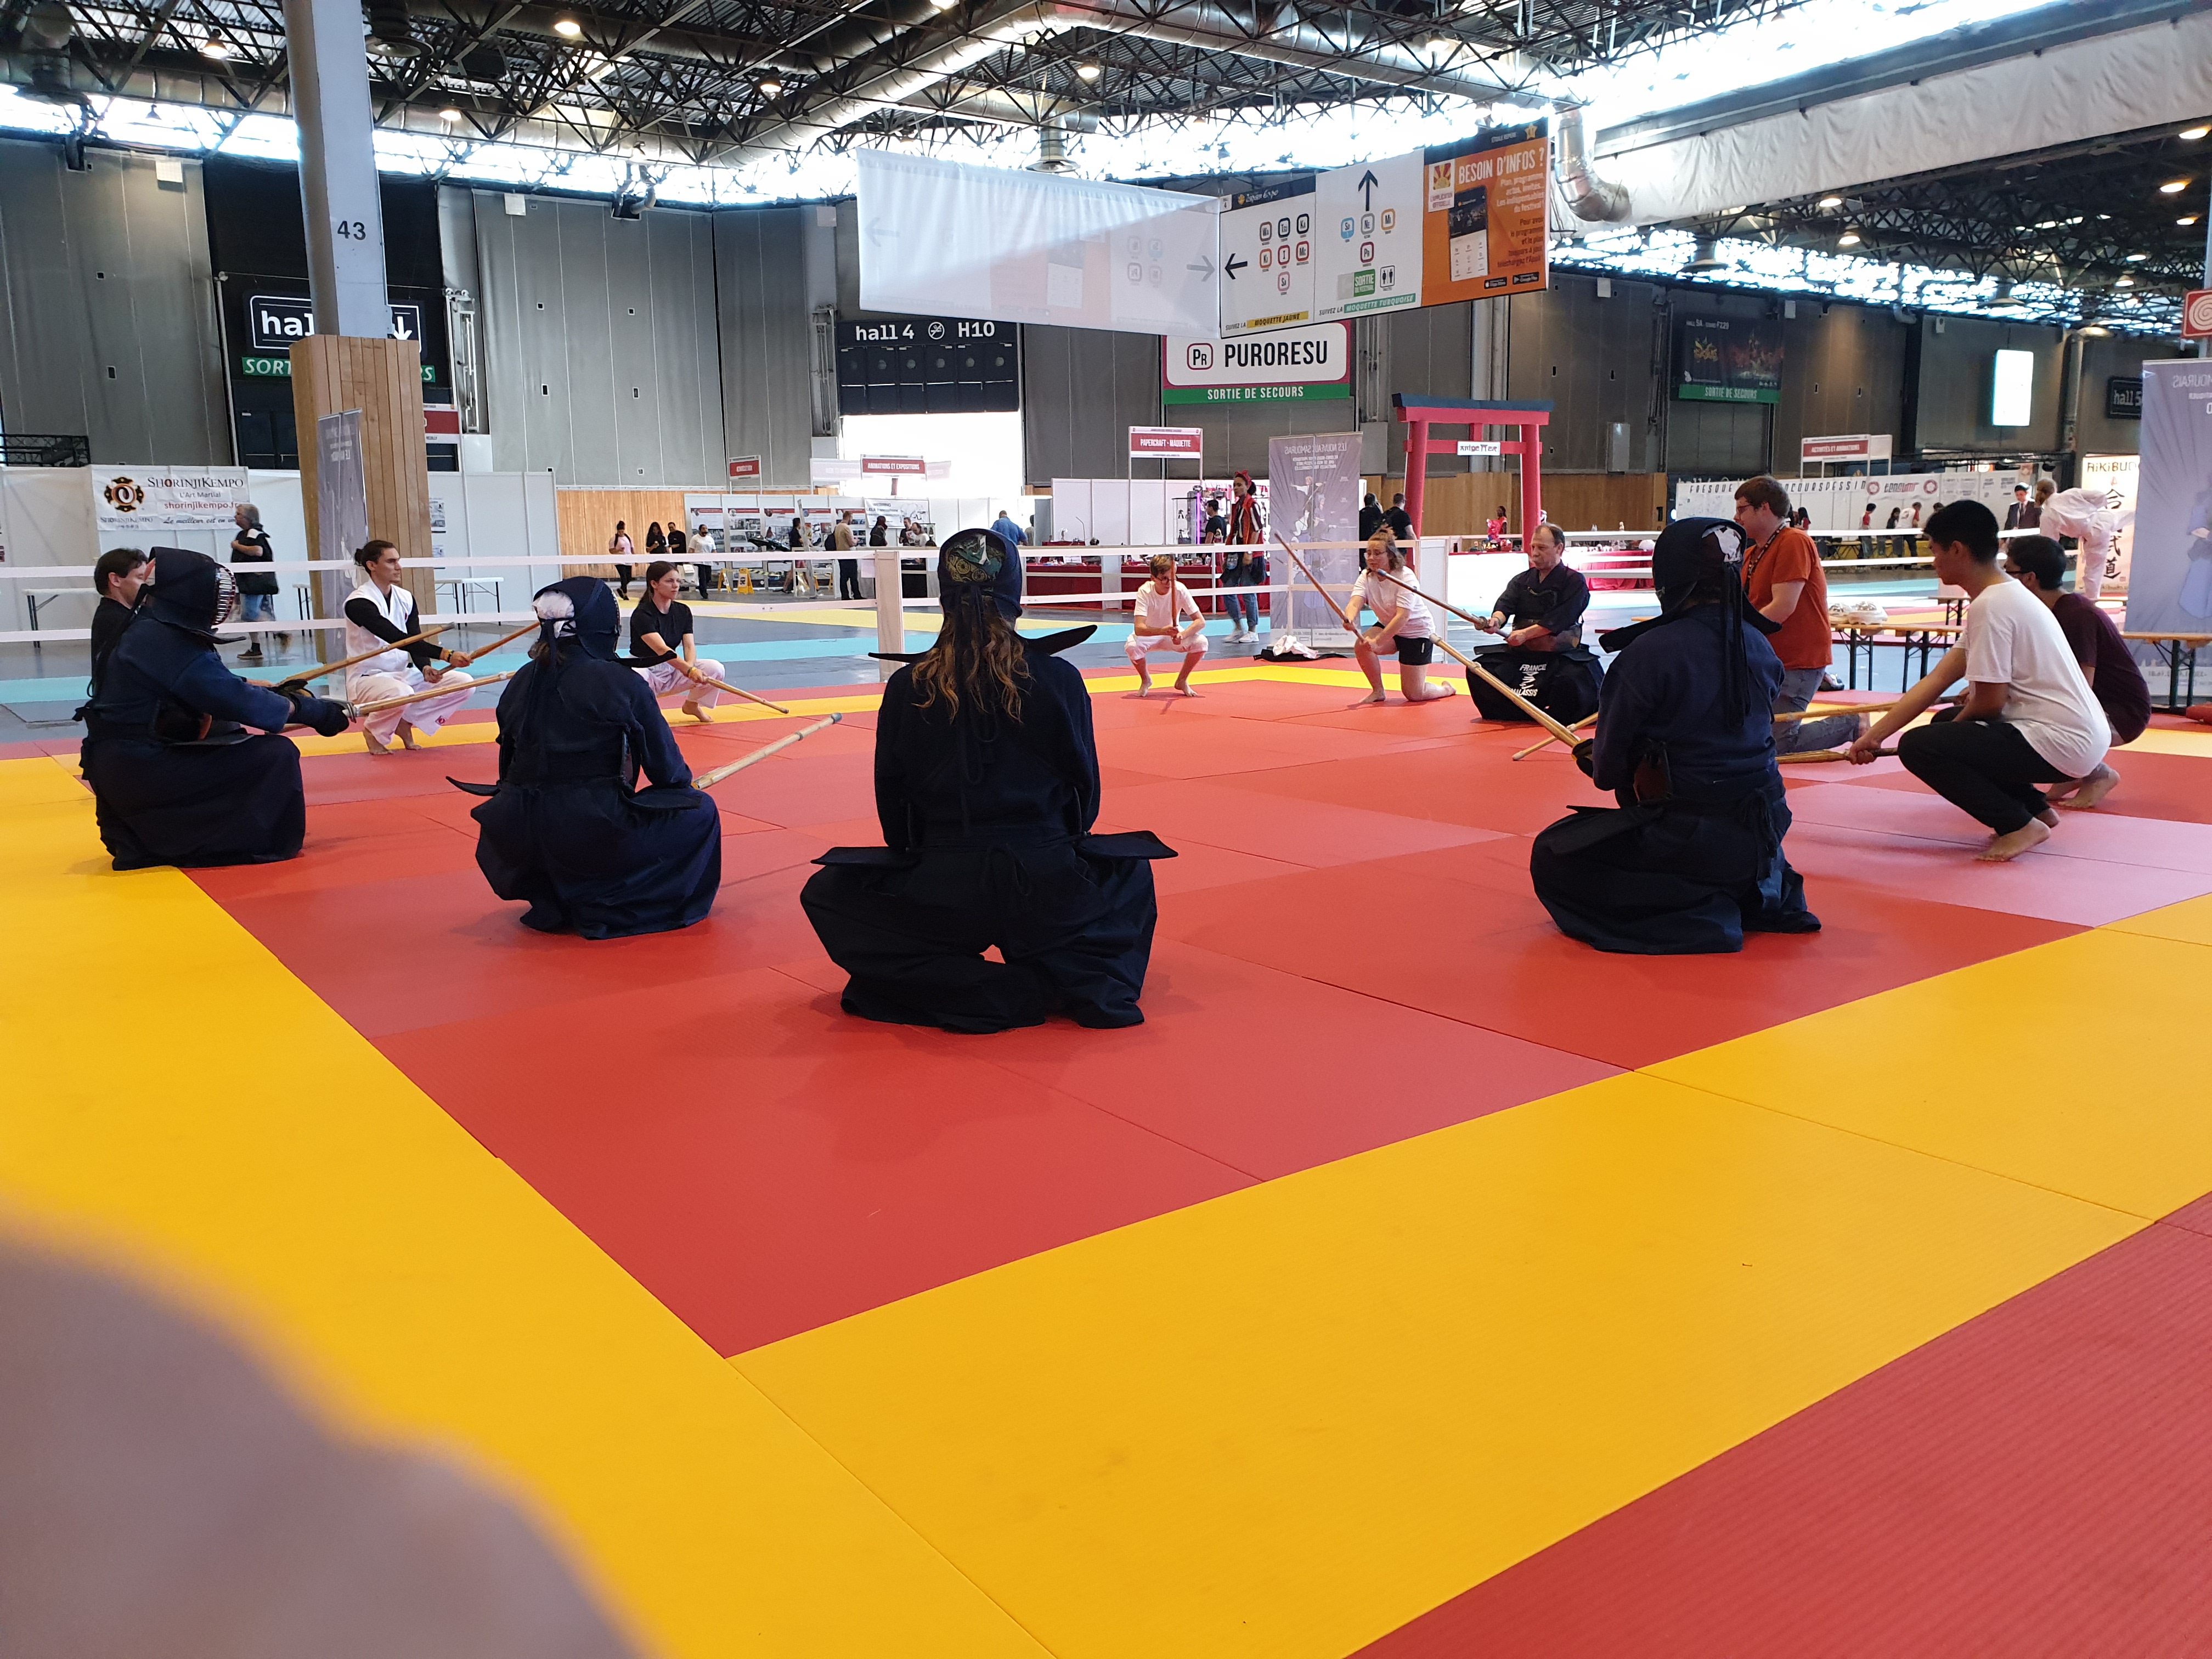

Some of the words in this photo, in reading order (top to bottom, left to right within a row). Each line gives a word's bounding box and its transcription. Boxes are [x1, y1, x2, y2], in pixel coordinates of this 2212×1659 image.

[1459, 159, 1493, 184] BESOIN
[1497, 149, 1536, 176] D'INFOS
[1539, 147, 1544, 167] ?
[337, 221, 366, 240] 43
[1355, 274, 1374, 286] SORTIE
[1318, 307, 1336, 316] SUIVEZ
[1346, 300, 1378, 312] MOQUETTE
[1379, 295, 1414, 306] TURQUOISE
[261, 310, 315, 336] hal
[1255, 315, 1282, 326] MOQUETTE
[1283, 313, 1300, 323] JAUNE
[855, 324, 899, 341] hall
[902, 324, 915, 339] 4
[958, 321, 996, 338] H10
[1224, 340, 1328, 368] PURORESU
[245, 359, 292, 375] SORT
[1207, 387, 1241, 400] SORTIE
[1245, 387, 1257, 399] DE
[1260, 386, 1304, 398] SECOURS
[1705, 387, 1724, 397] SORTIE
[1726, 387, 1733, 398] DE
[1734, 388, 1758, 399] SECOURS
[2113, 390, 2134, 407] hall
[148, 477, 244, 488] SHORINJIKEMPO
[1689, 483, 1733, 494] FRESQUE
[164, 501, 237, 510] shorinjikempo.fr
